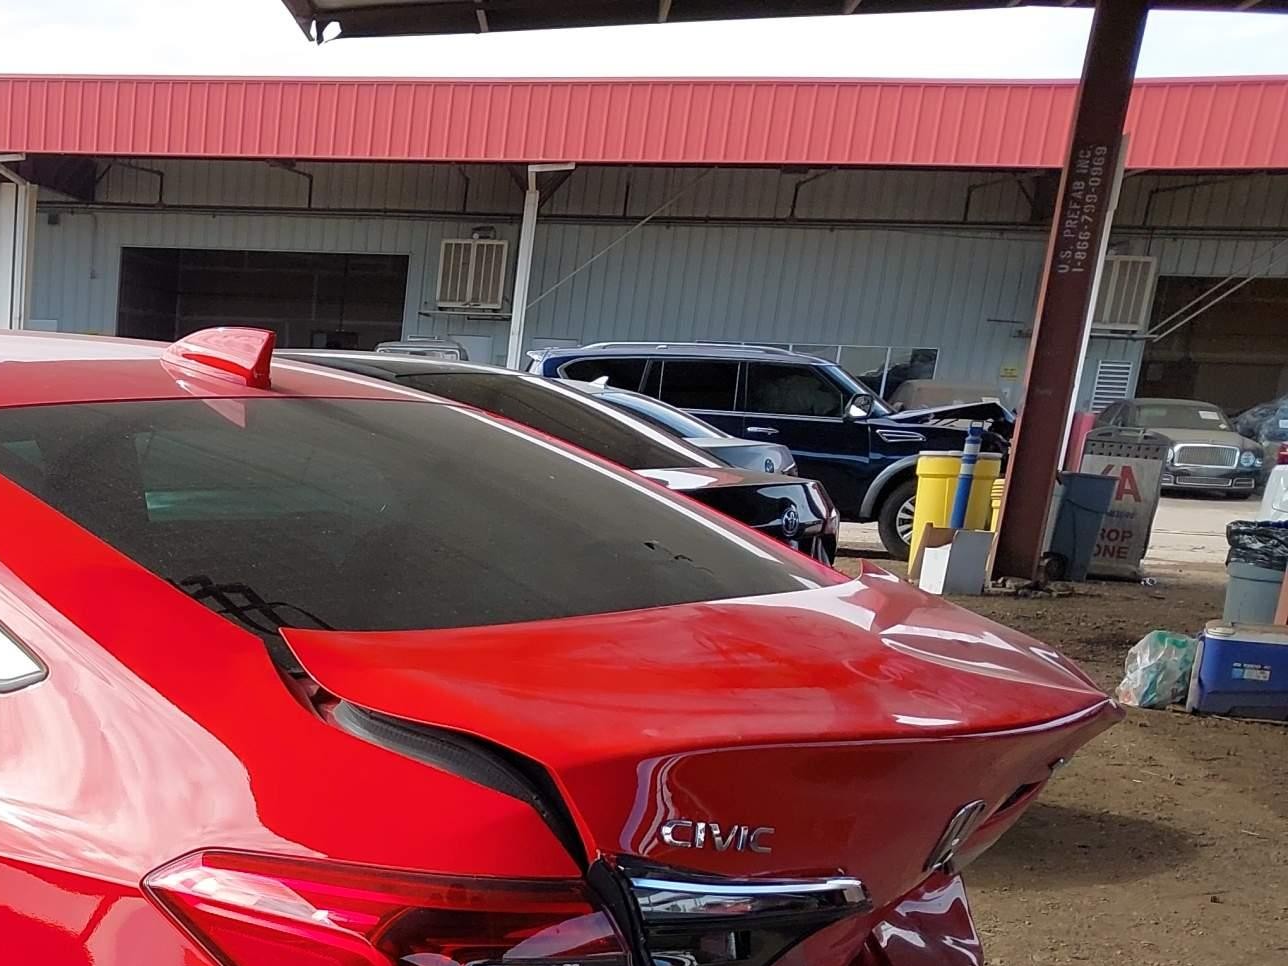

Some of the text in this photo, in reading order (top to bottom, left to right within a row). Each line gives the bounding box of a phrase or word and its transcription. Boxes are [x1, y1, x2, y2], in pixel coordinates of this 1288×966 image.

[1057, 144, 1093, 273] U.S. PREFAB INC.
[1071, 145, 1108, 273] 1-866-799-0969
[660, 818, 776, 854] CIVIC
